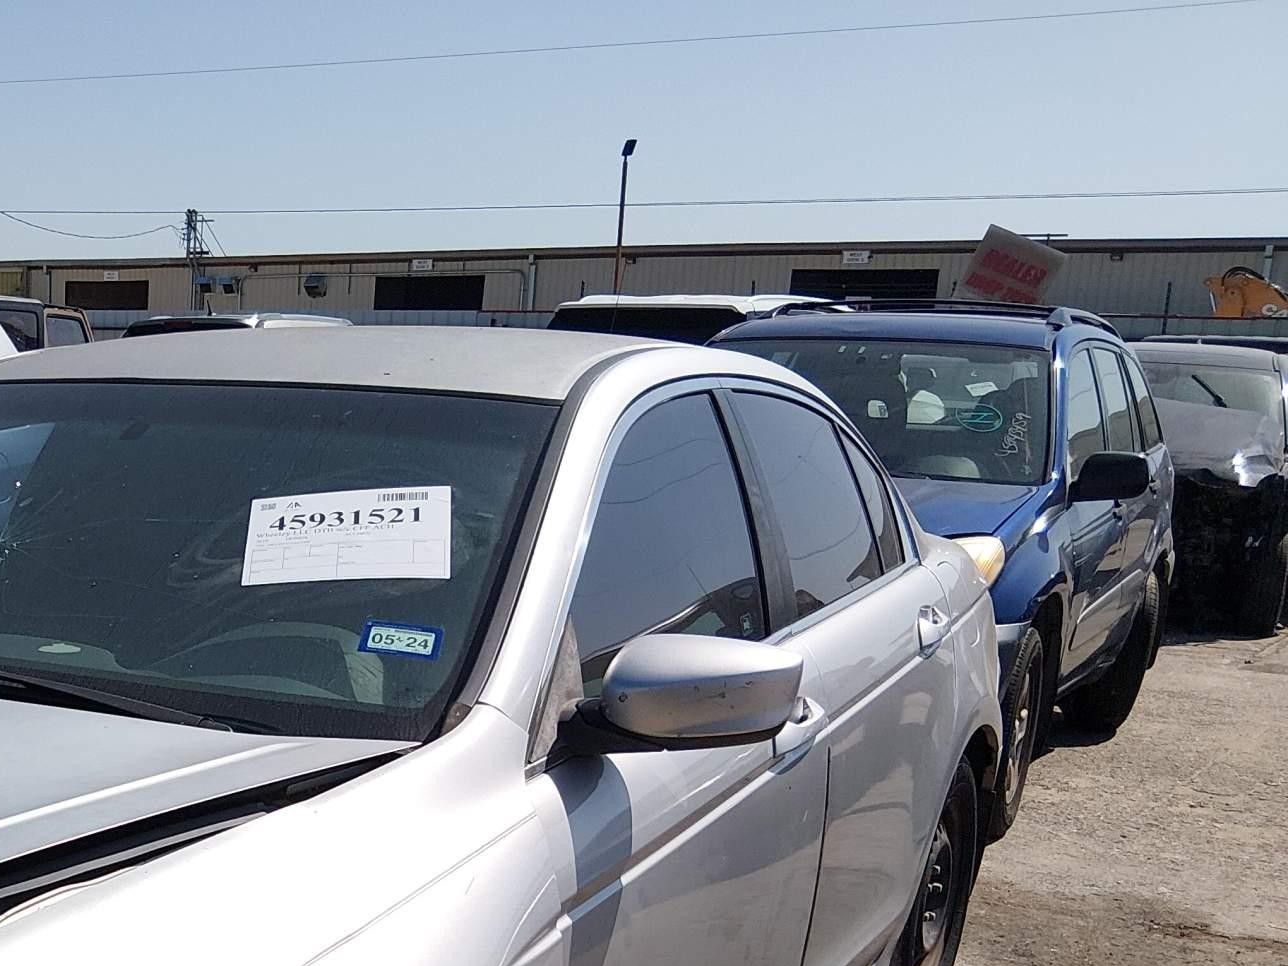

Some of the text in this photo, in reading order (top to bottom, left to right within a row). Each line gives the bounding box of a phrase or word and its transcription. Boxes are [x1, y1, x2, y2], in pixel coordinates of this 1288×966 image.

[268, 506, 424, 531] 45931521
[371, 632, 396, 646] 05
[405, 636, 430, 650] 24
